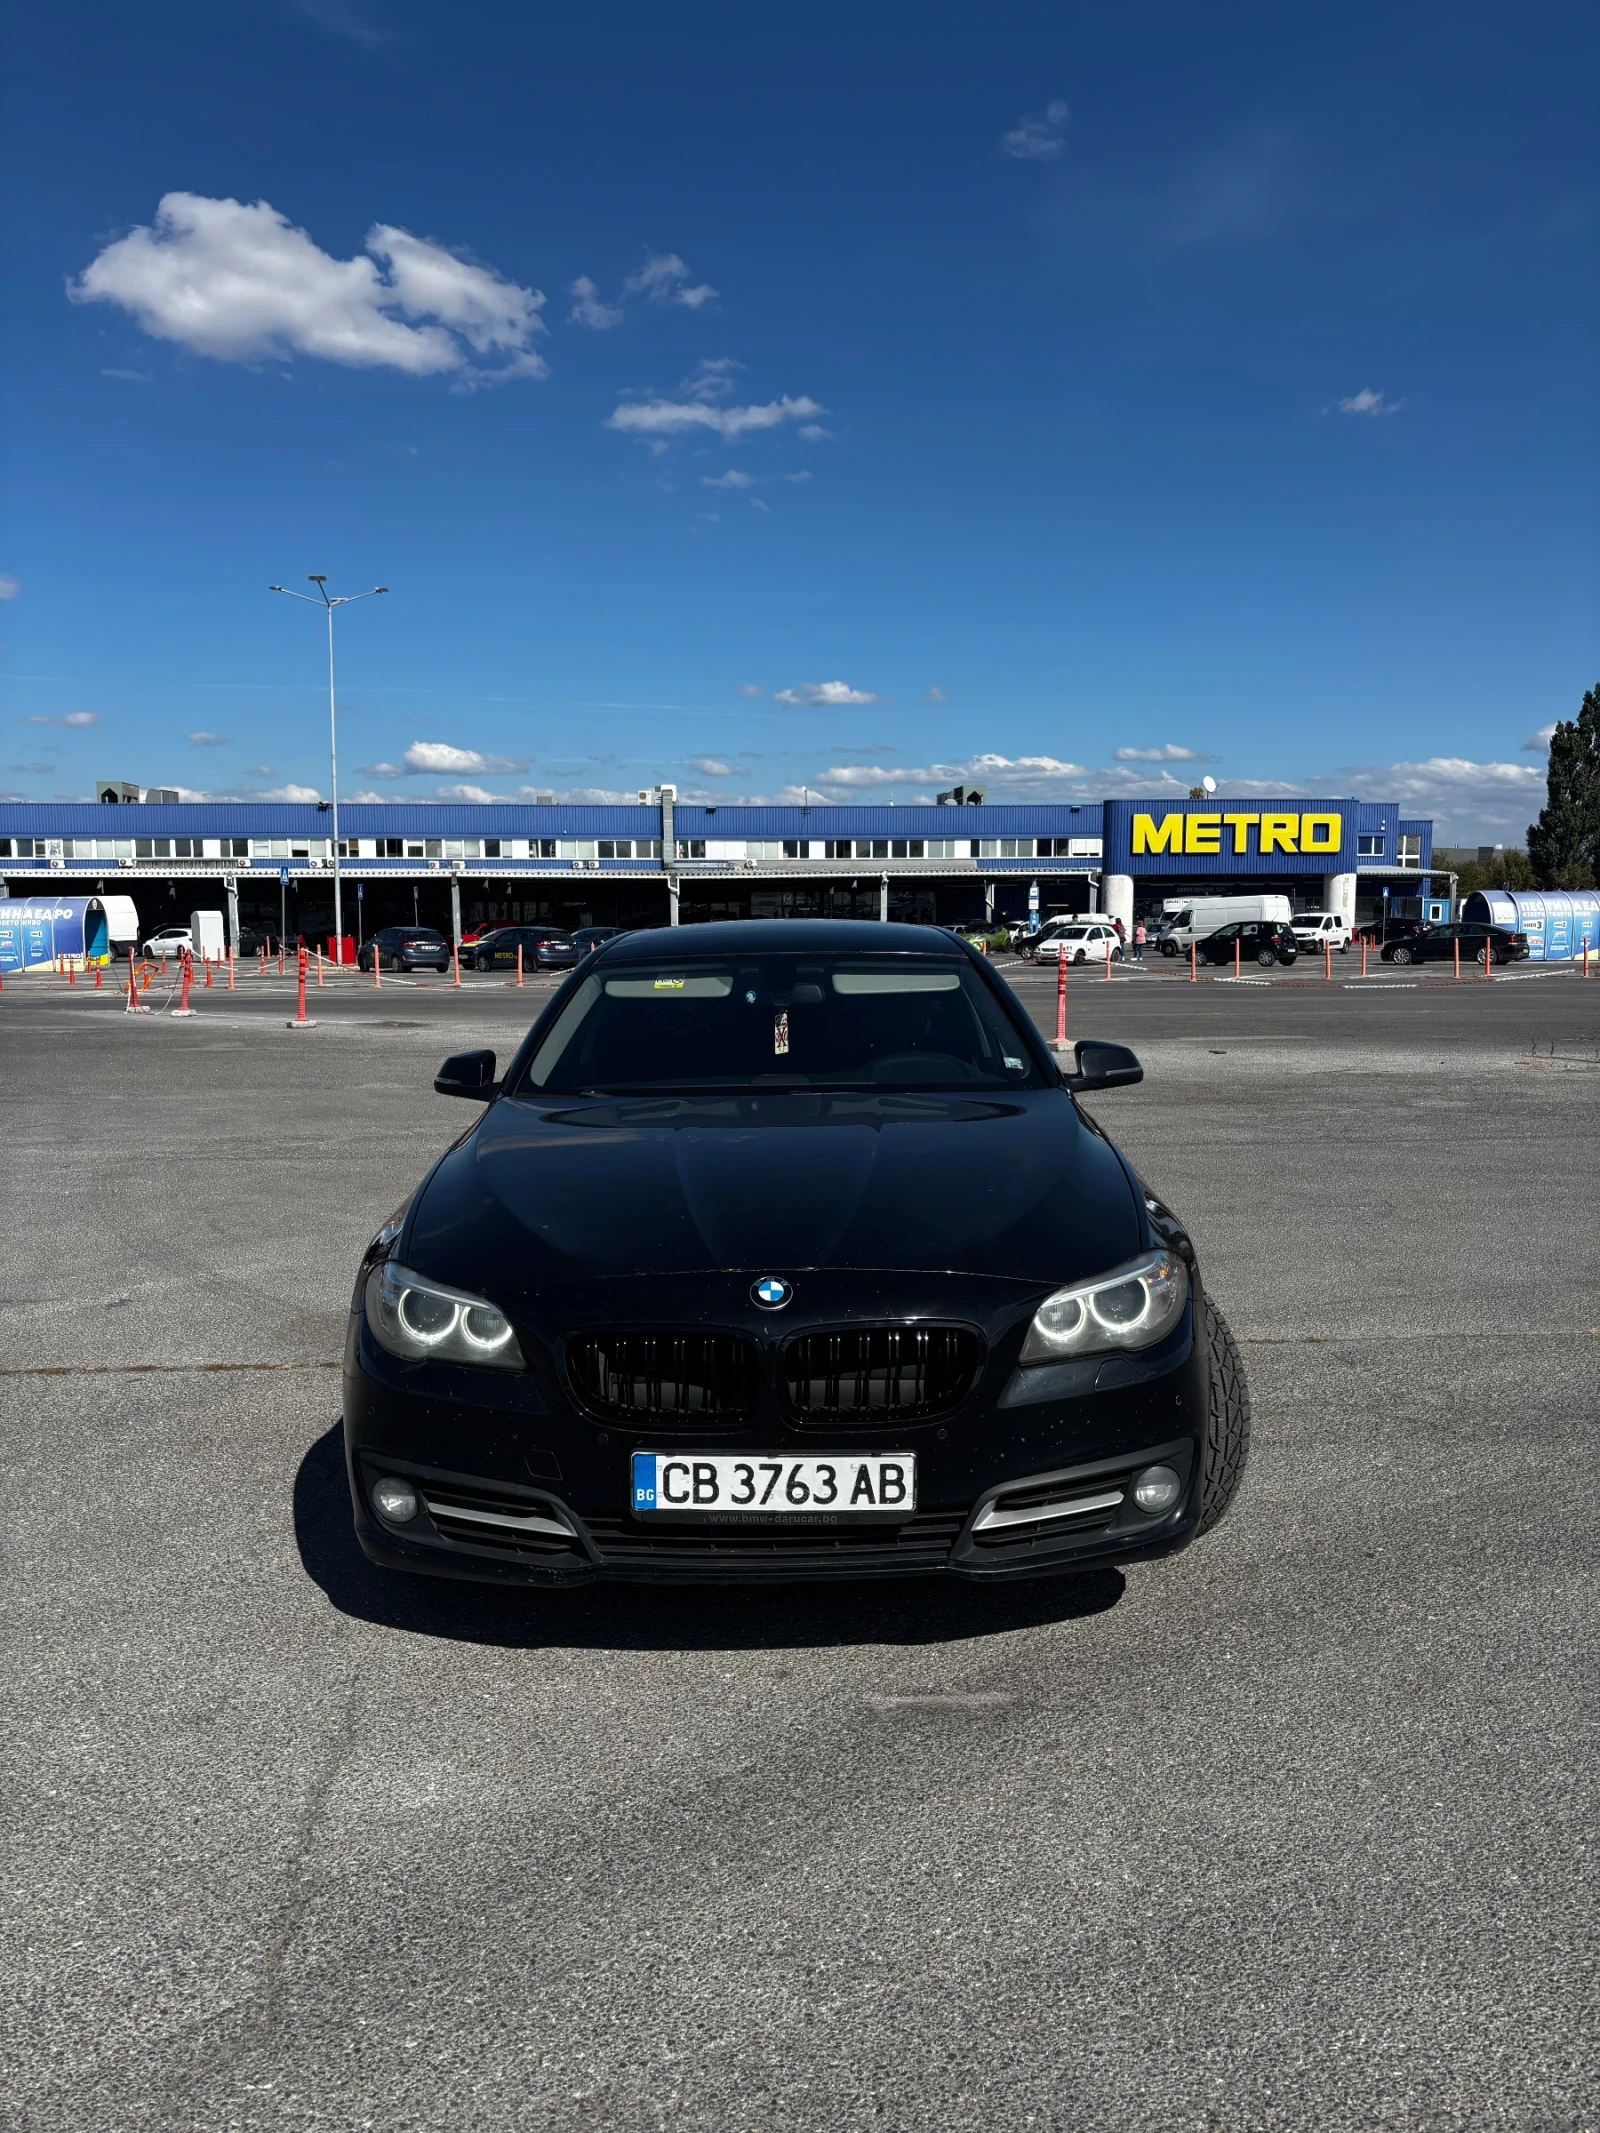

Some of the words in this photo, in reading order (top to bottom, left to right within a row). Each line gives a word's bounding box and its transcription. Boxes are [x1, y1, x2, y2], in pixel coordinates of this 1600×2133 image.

[1132, 813, 1342, 854] METRO
[636, 1489, 655, 1501] BG
[662, 1462, 720, 1505] CB
[730, 1463, 838, 1506] 3763
[849, 1463, 907, 1505] AB
